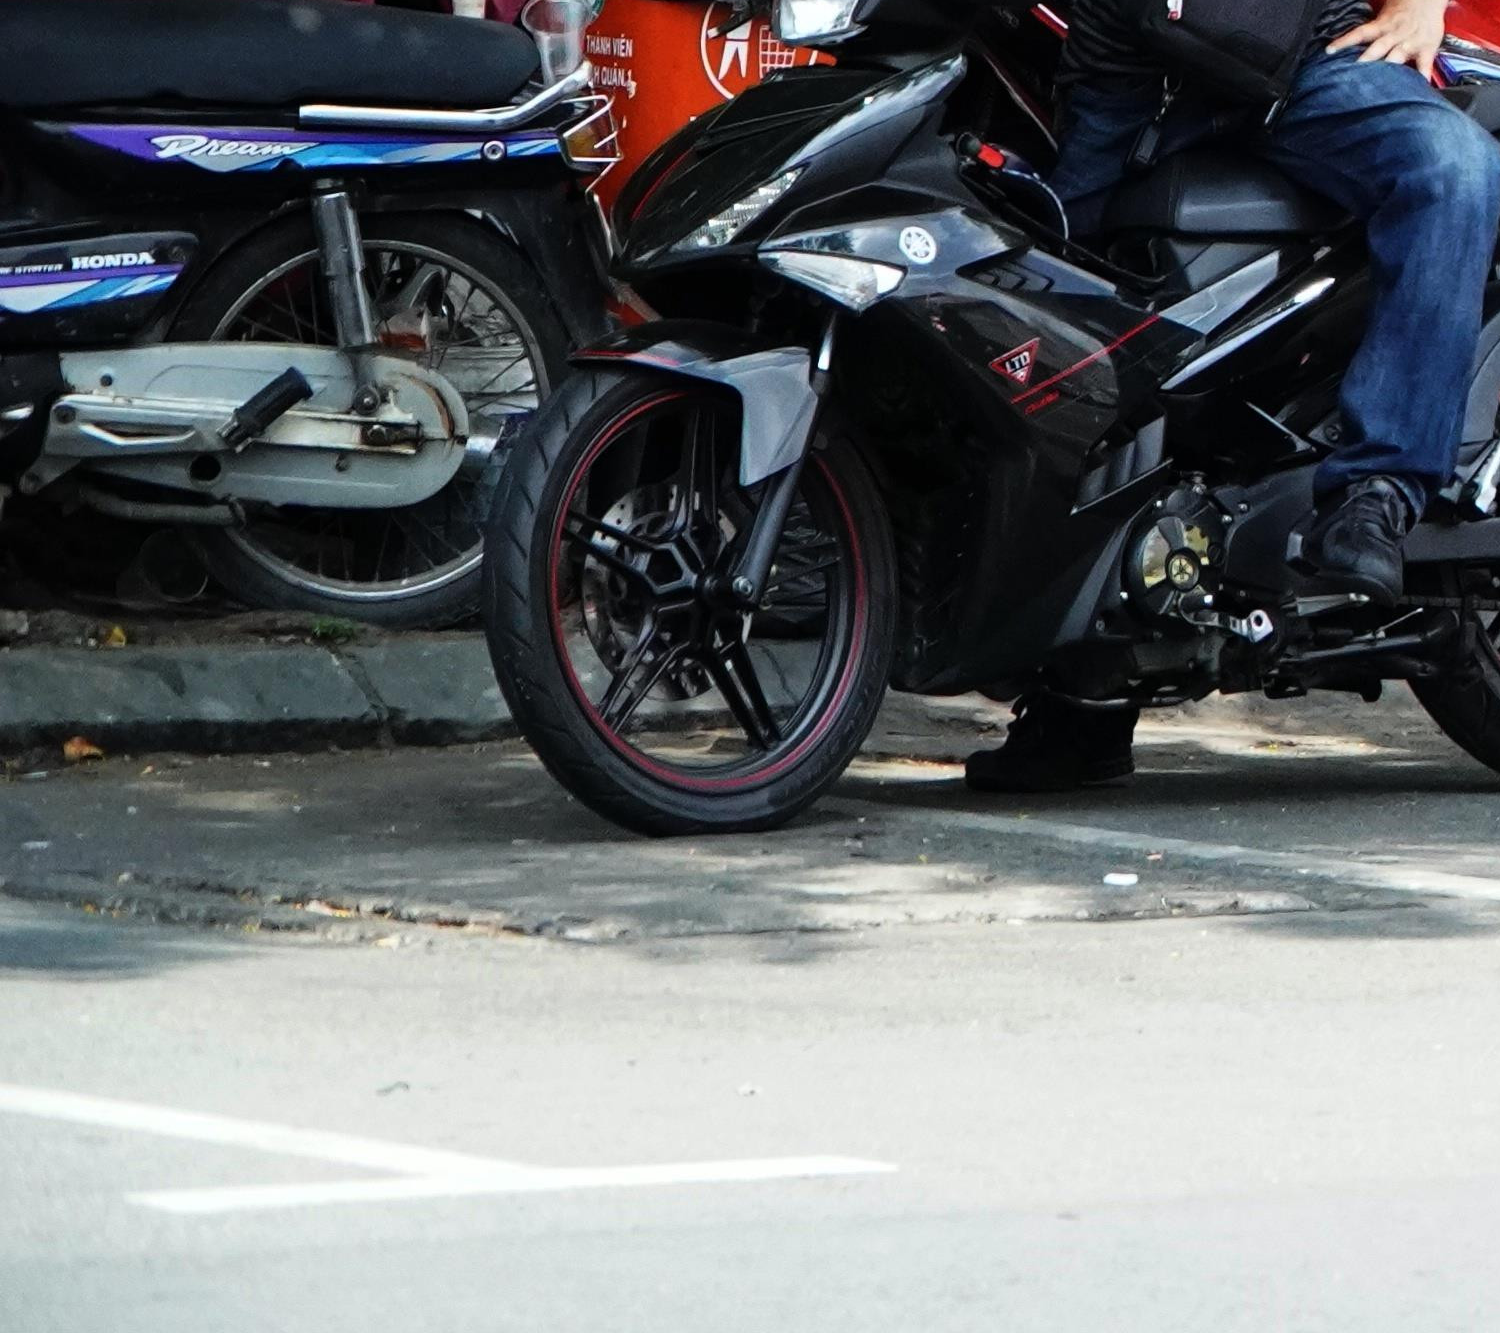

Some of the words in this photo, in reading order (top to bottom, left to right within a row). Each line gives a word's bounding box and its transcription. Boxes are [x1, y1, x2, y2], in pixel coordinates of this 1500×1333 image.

[587, 31, 611, 55] THÀNH
[612, 33, 633, 58] VIÊN
[151, 135, 312, 157] Dream
[72, 252, 155, 270] HONDA
[1005, 351, 1030, 374] LTD
